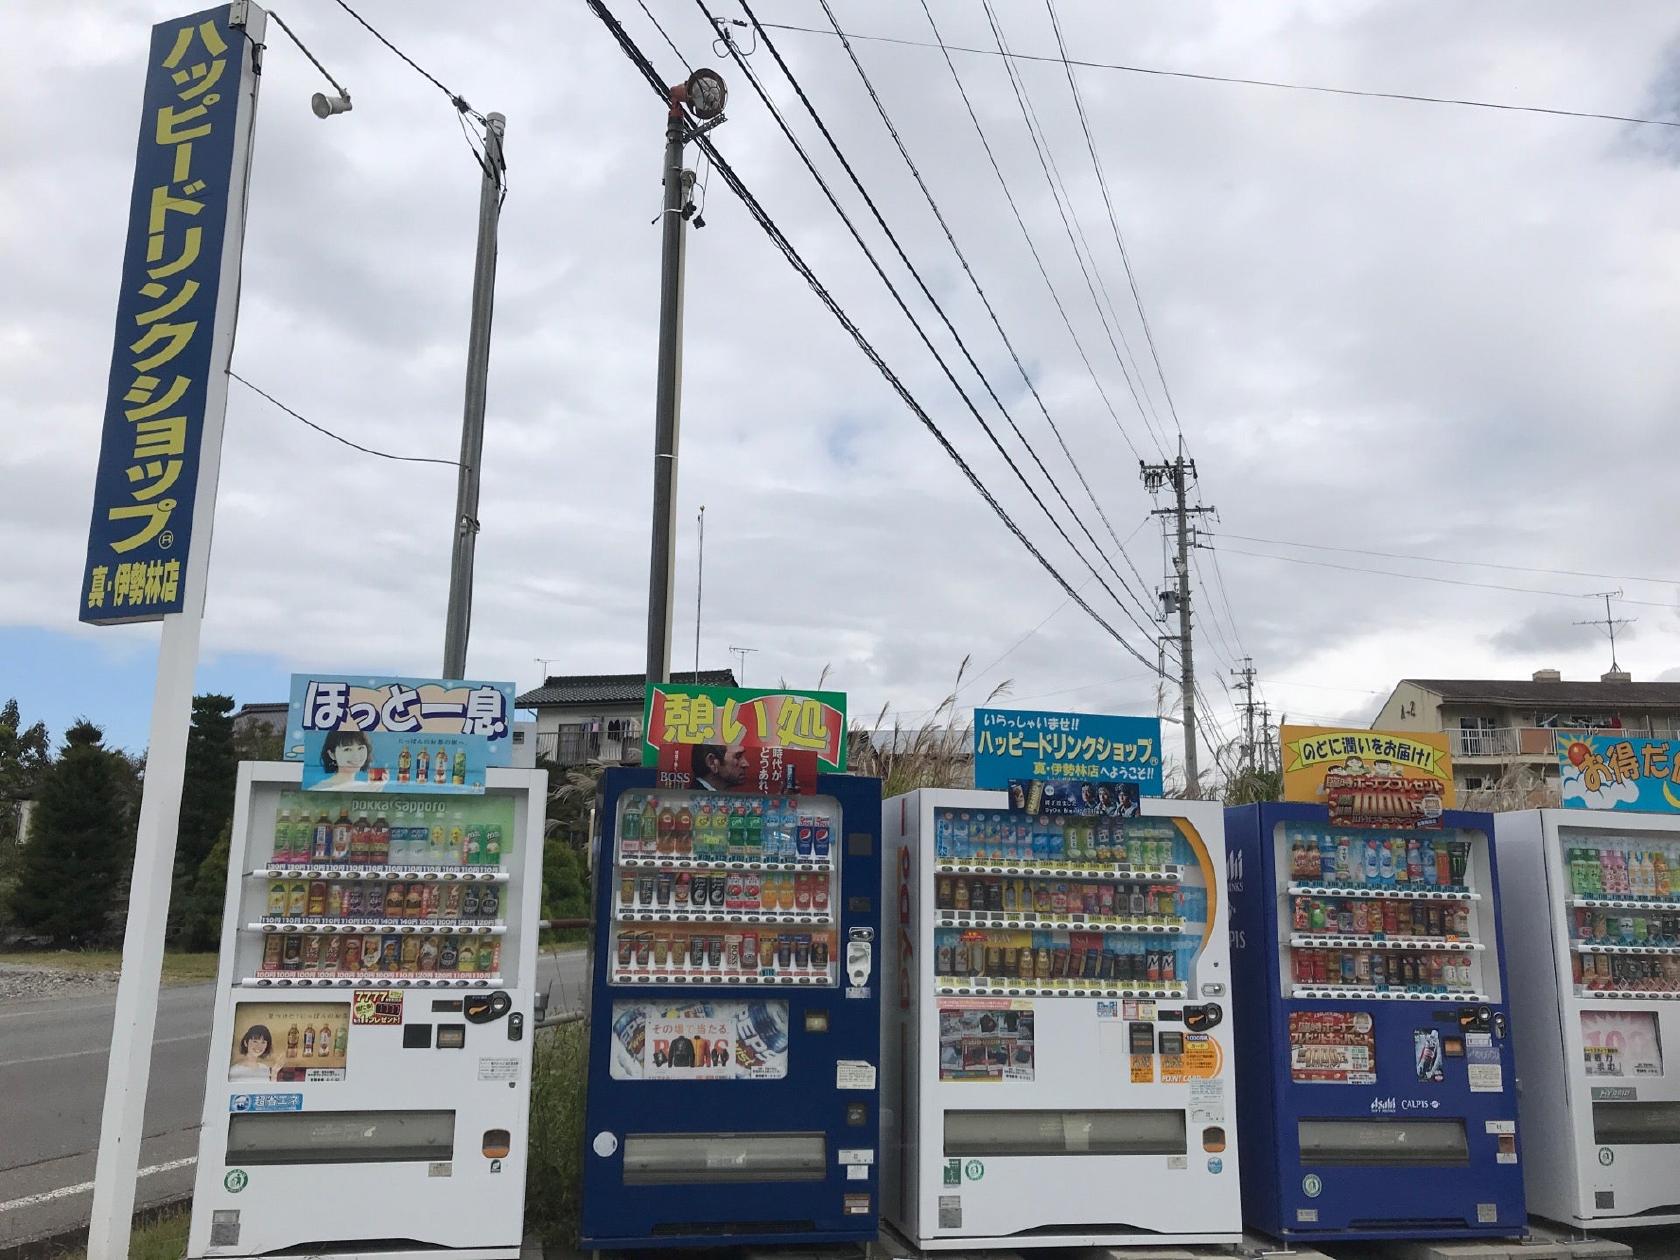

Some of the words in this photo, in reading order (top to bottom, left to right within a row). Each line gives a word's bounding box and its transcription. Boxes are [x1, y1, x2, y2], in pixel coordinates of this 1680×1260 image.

[109, 19, 229, 554] ハッピードリンクショップ
[302, 680, 509, 741] ほっと一息
[662, 693, 828, 749] 憩い処
[977, 730, 1153, 764] ハッピードリンクショップ
[660, 771, 690, 783] BOSS
[355, 991, 388, 1002] 7777
[1401, 1099, 1429, 1110] CALPIS
